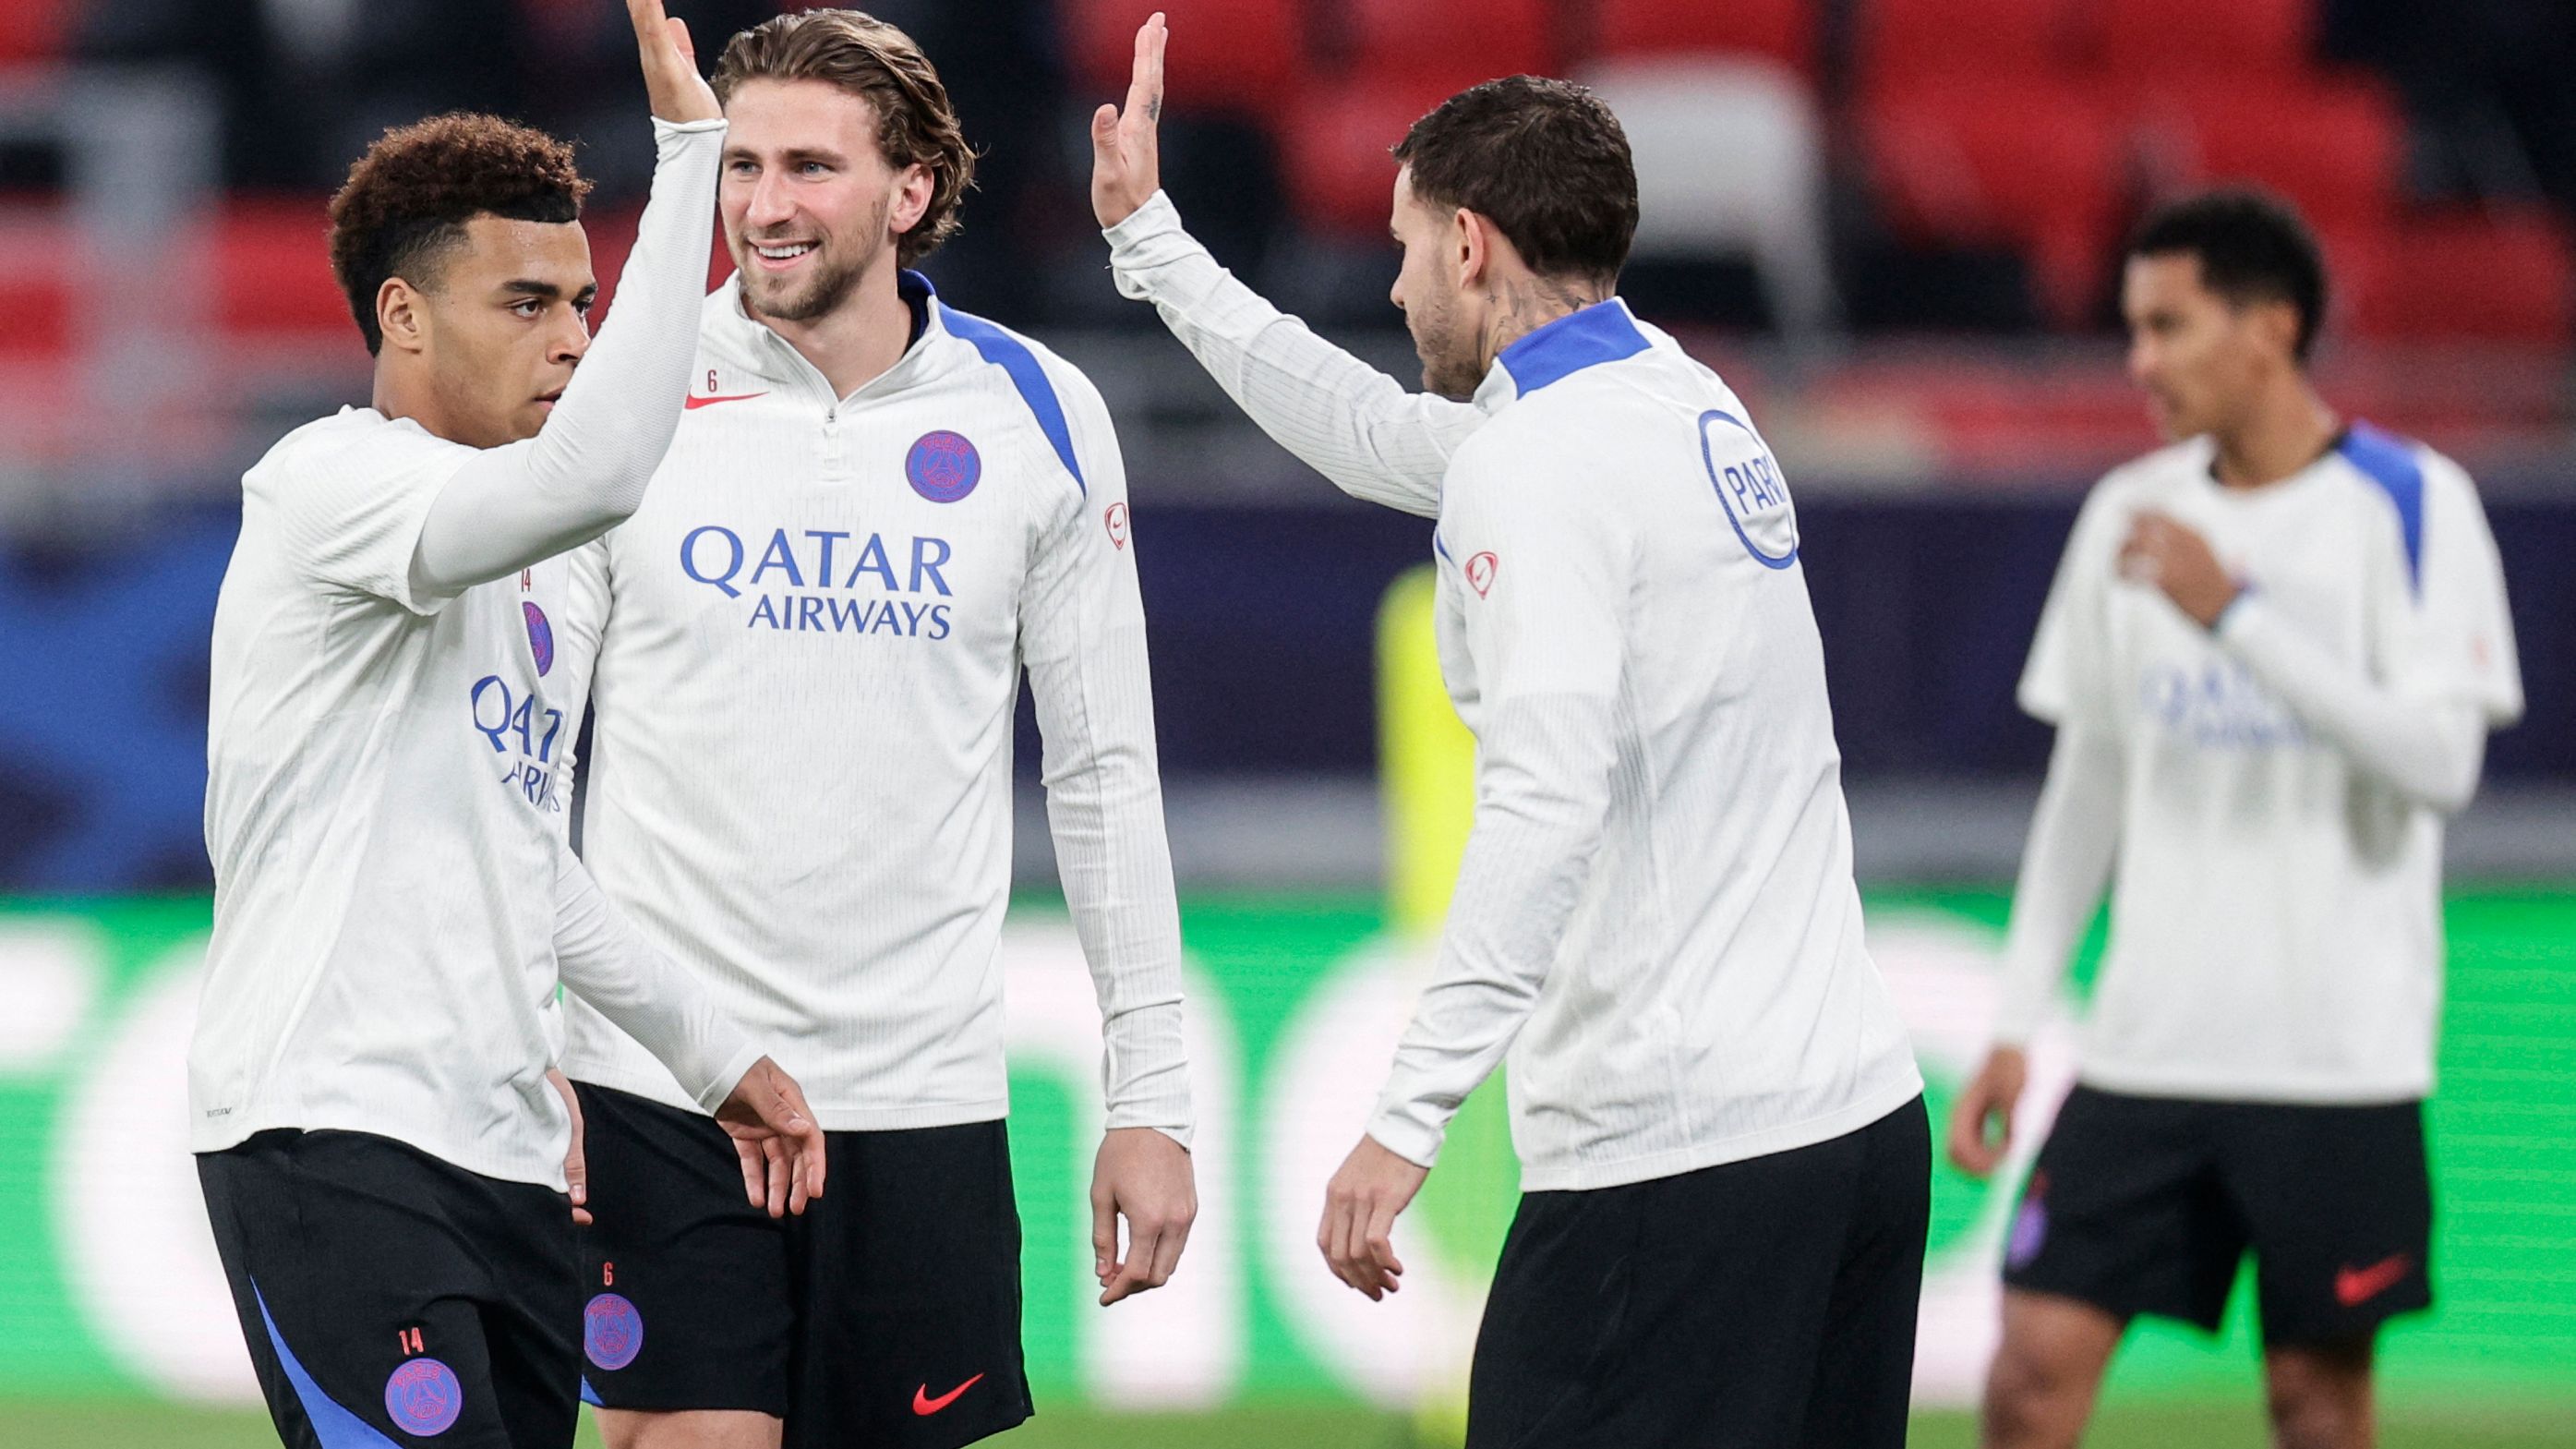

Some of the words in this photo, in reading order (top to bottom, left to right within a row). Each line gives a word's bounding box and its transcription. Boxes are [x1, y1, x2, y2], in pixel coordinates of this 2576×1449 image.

[707, 369, 717, 392] 6
[680, 525, 953, 599] QATAR
[521, 567, 532, 593] 14
[748, 593, 951, 641] AIRWAYS
[470, 674, 565, 766] QAT
[603, 1262, 613, 1286] 6
[398, 1327, 424, 1356] 14
